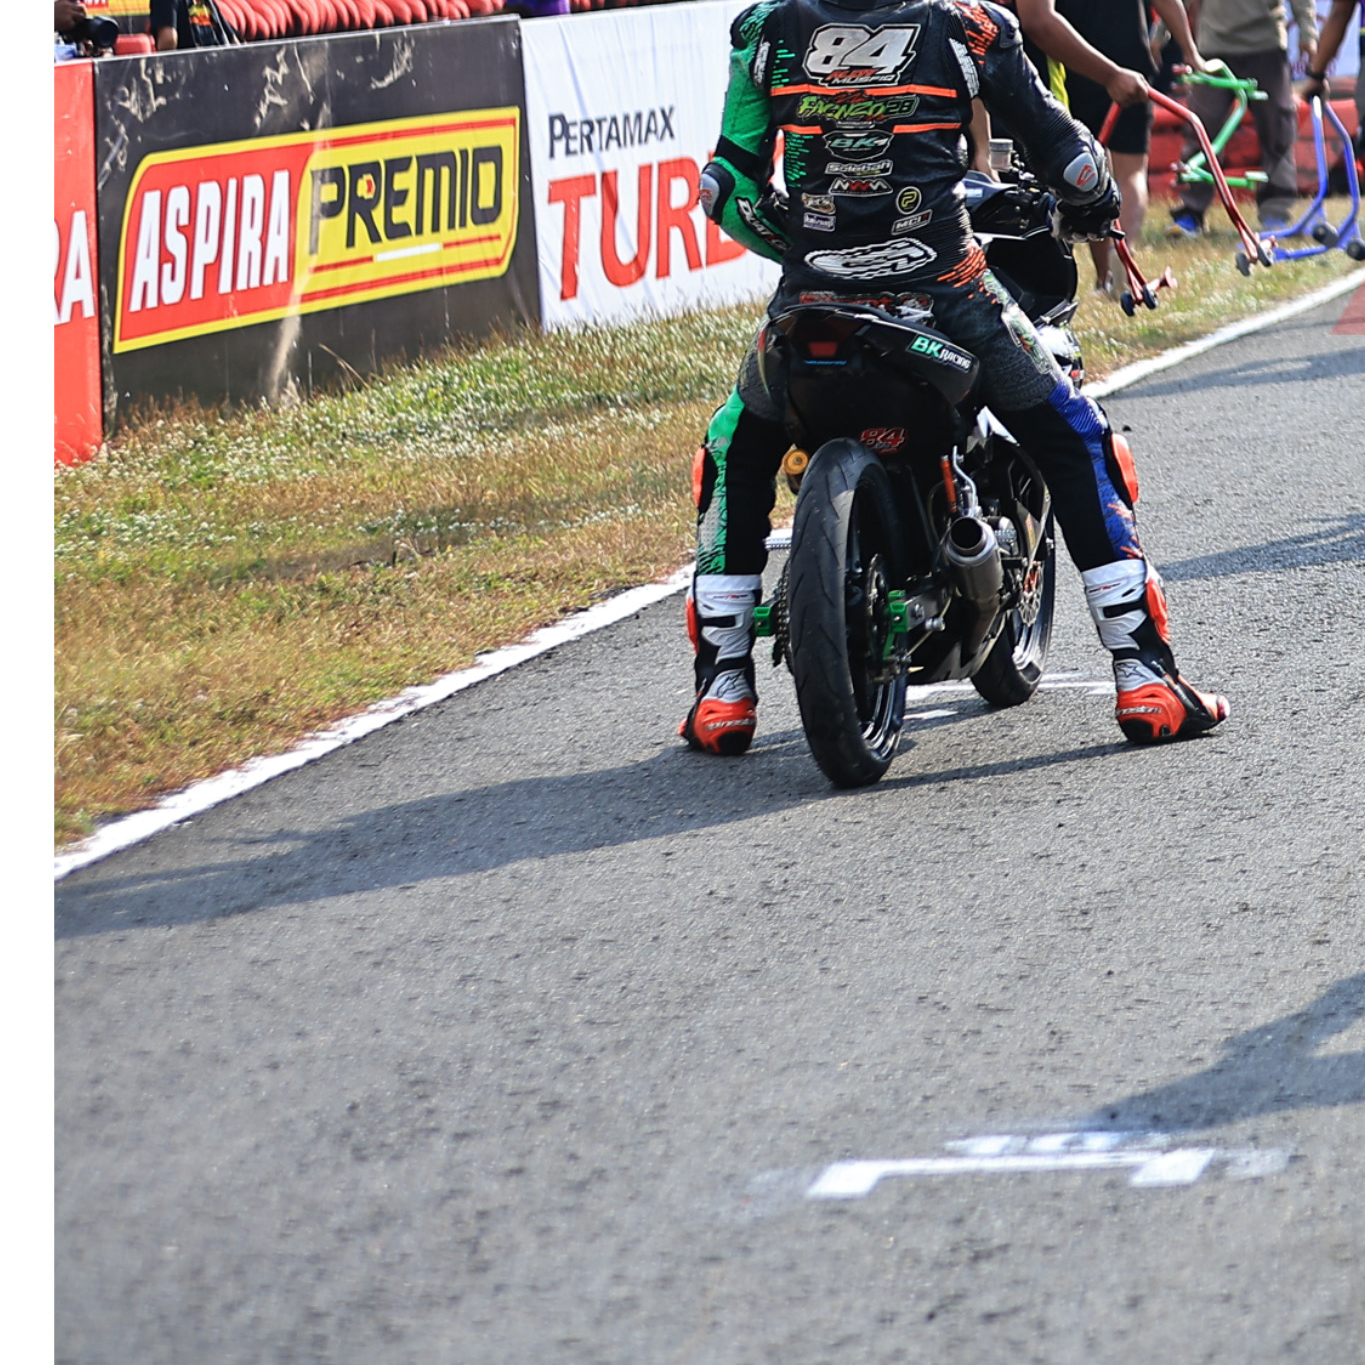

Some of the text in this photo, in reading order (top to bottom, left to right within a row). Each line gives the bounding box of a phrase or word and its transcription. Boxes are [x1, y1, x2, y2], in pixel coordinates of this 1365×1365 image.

[806, 27, 916, 75] 84
[548, 106, 675, 160] PERTAMAX
[130, 170, 290, 314] ASPIRA
[310, 145, 504, 256] PREMIO
[911, 335, 941, 358] BK
